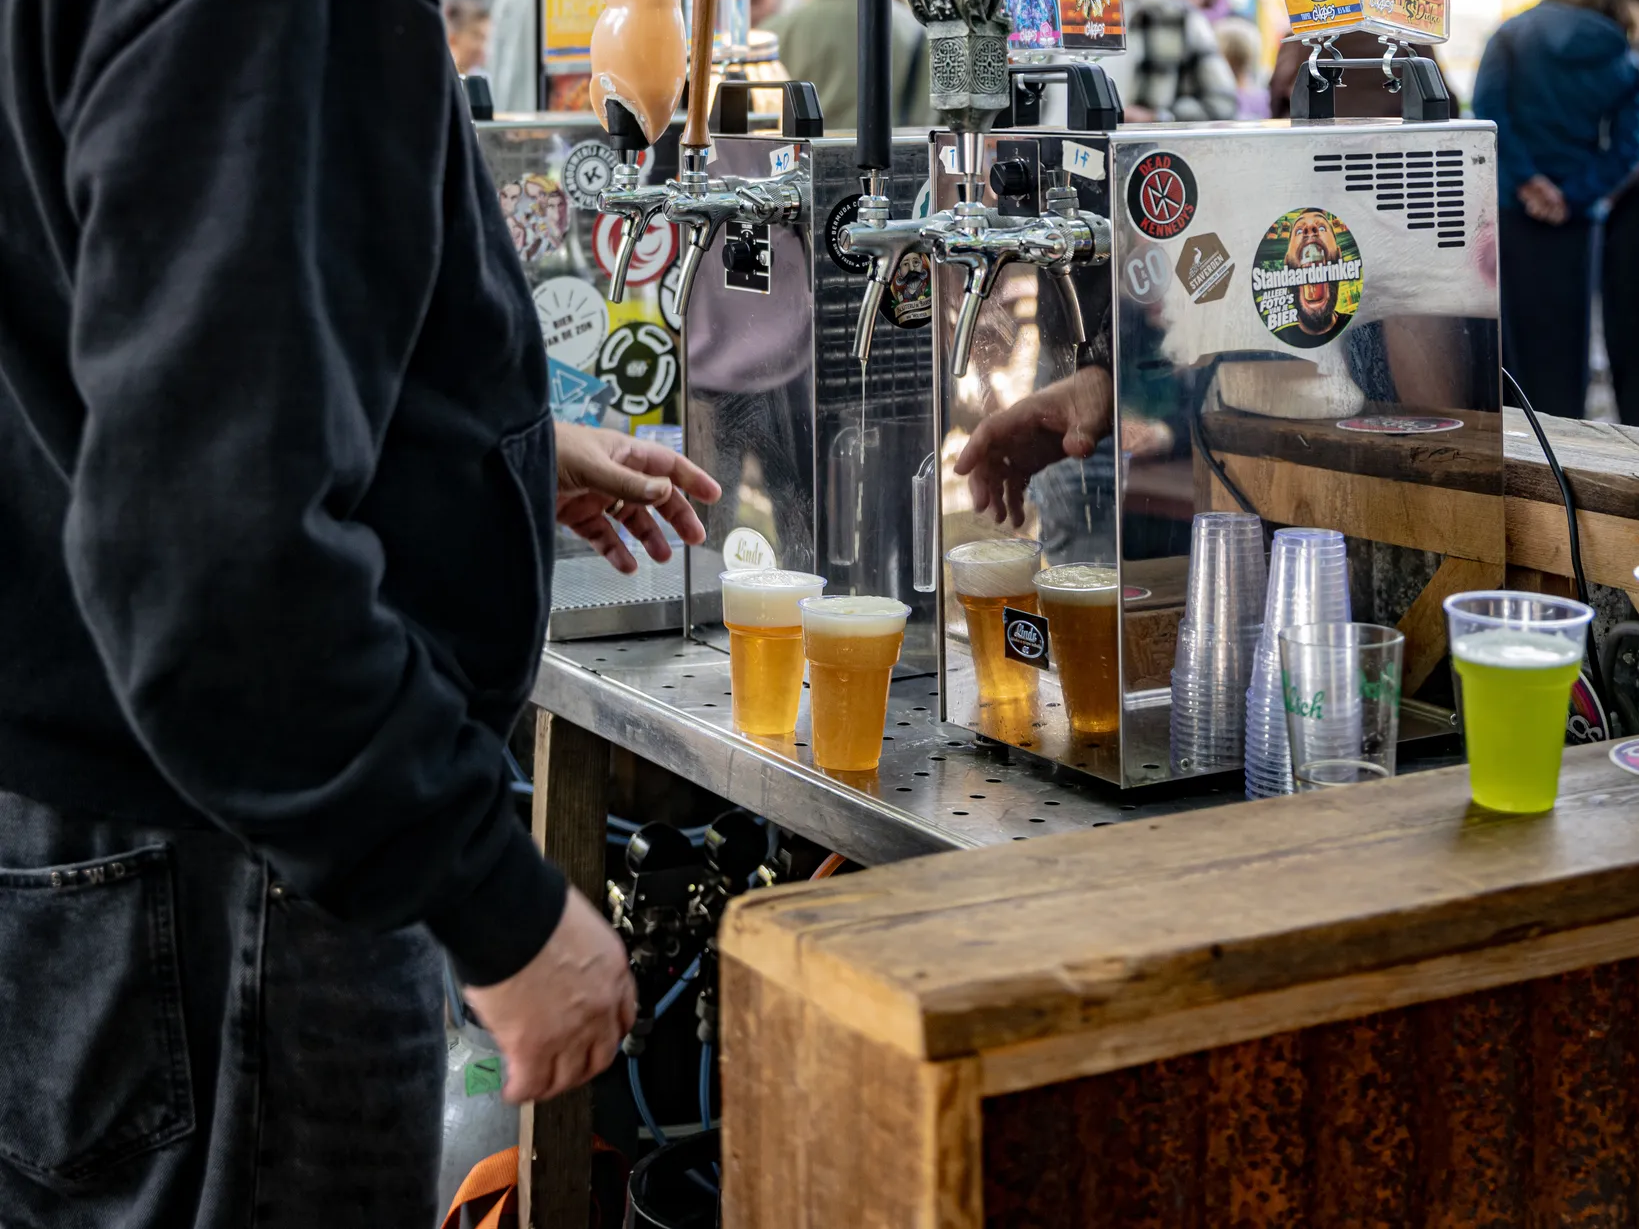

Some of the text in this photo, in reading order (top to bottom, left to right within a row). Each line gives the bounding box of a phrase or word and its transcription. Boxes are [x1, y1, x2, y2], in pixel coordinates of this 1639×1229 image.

[1138, 155, 1172, 176] DEAD
[832, 204, 851, 234] BERMUDA
[1140, 203, 1195, 237] KENNEDYS
[1189, 254, 1225, 290] STAVERDEN
[1252, 258, 1361, 291] Standaarddrinker
[1260, 293, 1294, 312] FOTO'S
[1262, 287, 1288, 300] ALLEEN
[1267, 308, 1298, 330] BIER
[1268, 304, 1288, 314] VAN JE
[553, 314, 573, 330] BIER
[562, 329, 571, 341] DE
[576, 321, 592, 335] ZON
